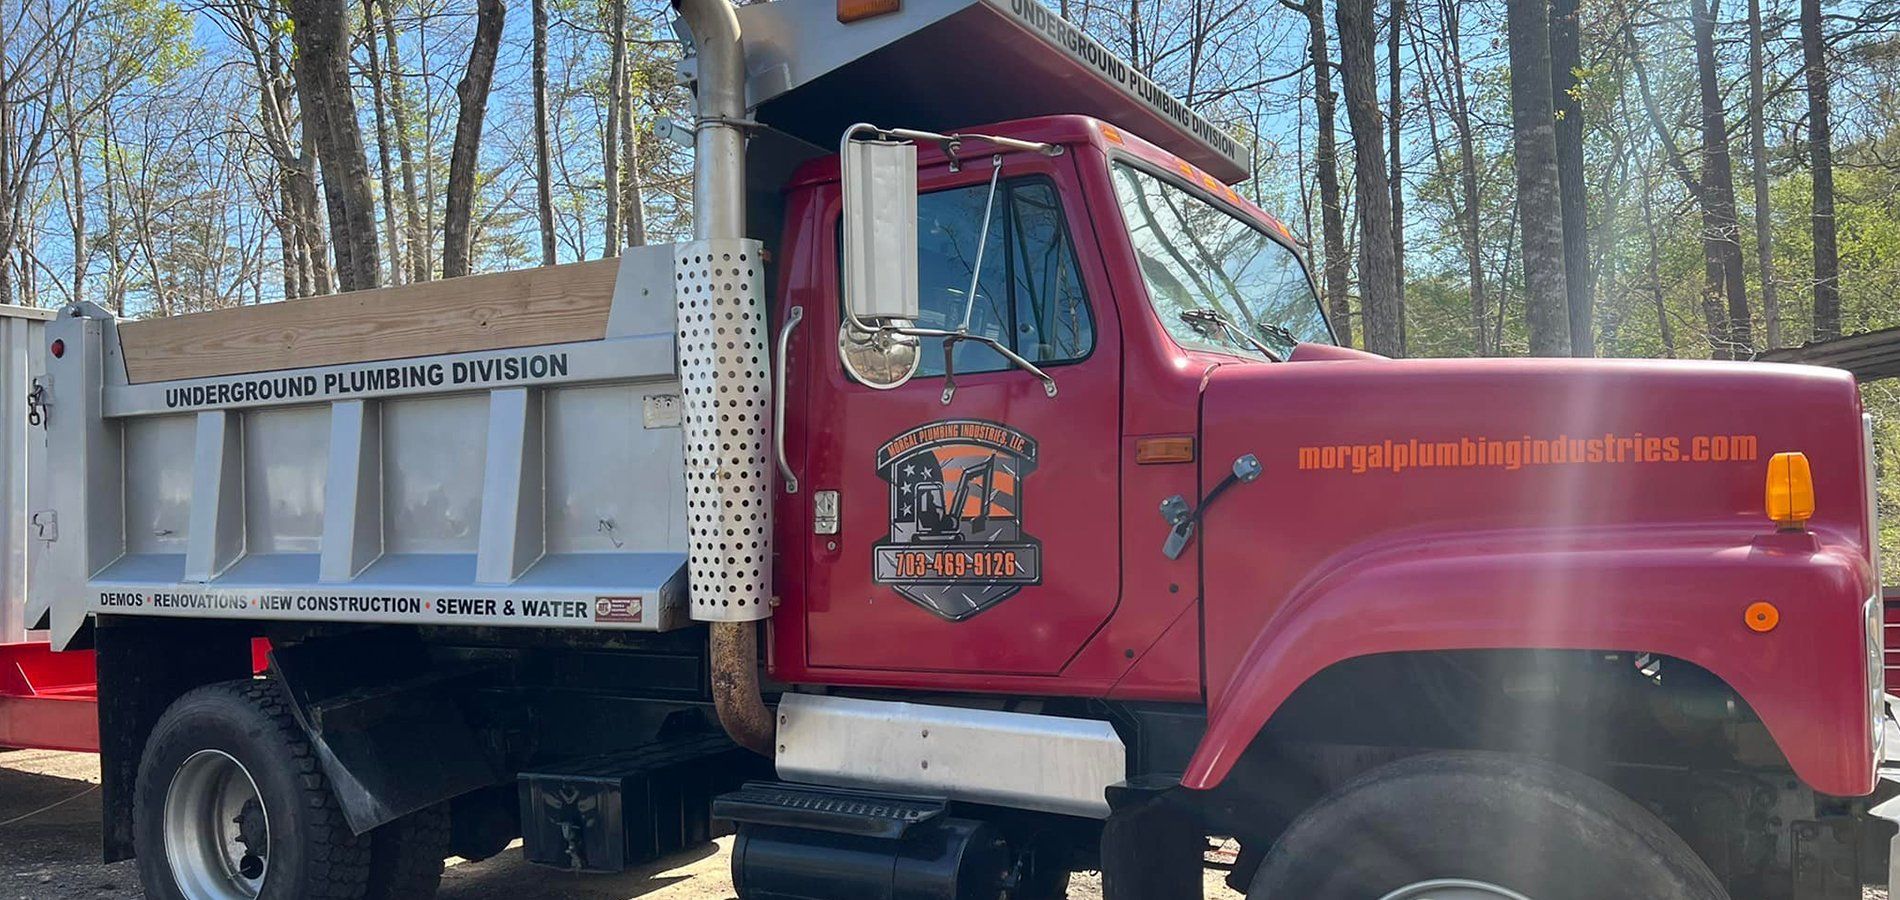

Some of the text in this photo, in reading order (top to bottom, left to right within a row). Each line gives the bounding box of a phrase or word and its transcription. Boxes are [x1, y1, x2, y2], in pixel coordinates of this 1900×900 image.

[1011, 0, 1235, 160] UNDERGROUND PLUMBING DIVISION
[166, 353, 568, 408] UNDERGROUND PLUMBING DIVISION
[887, 437, 918, 457] MORGAL
[919, 425, 959, 442] PLUMBING
[1298, 432, 1758, 474] morgalplumbingindustries.com
[895, 551, 1016, 577] 703-469-9126
[100, 592, 588, 618] DEMOS RENOVATIONS NEW CONSTRUCTION SEWER & WATER
